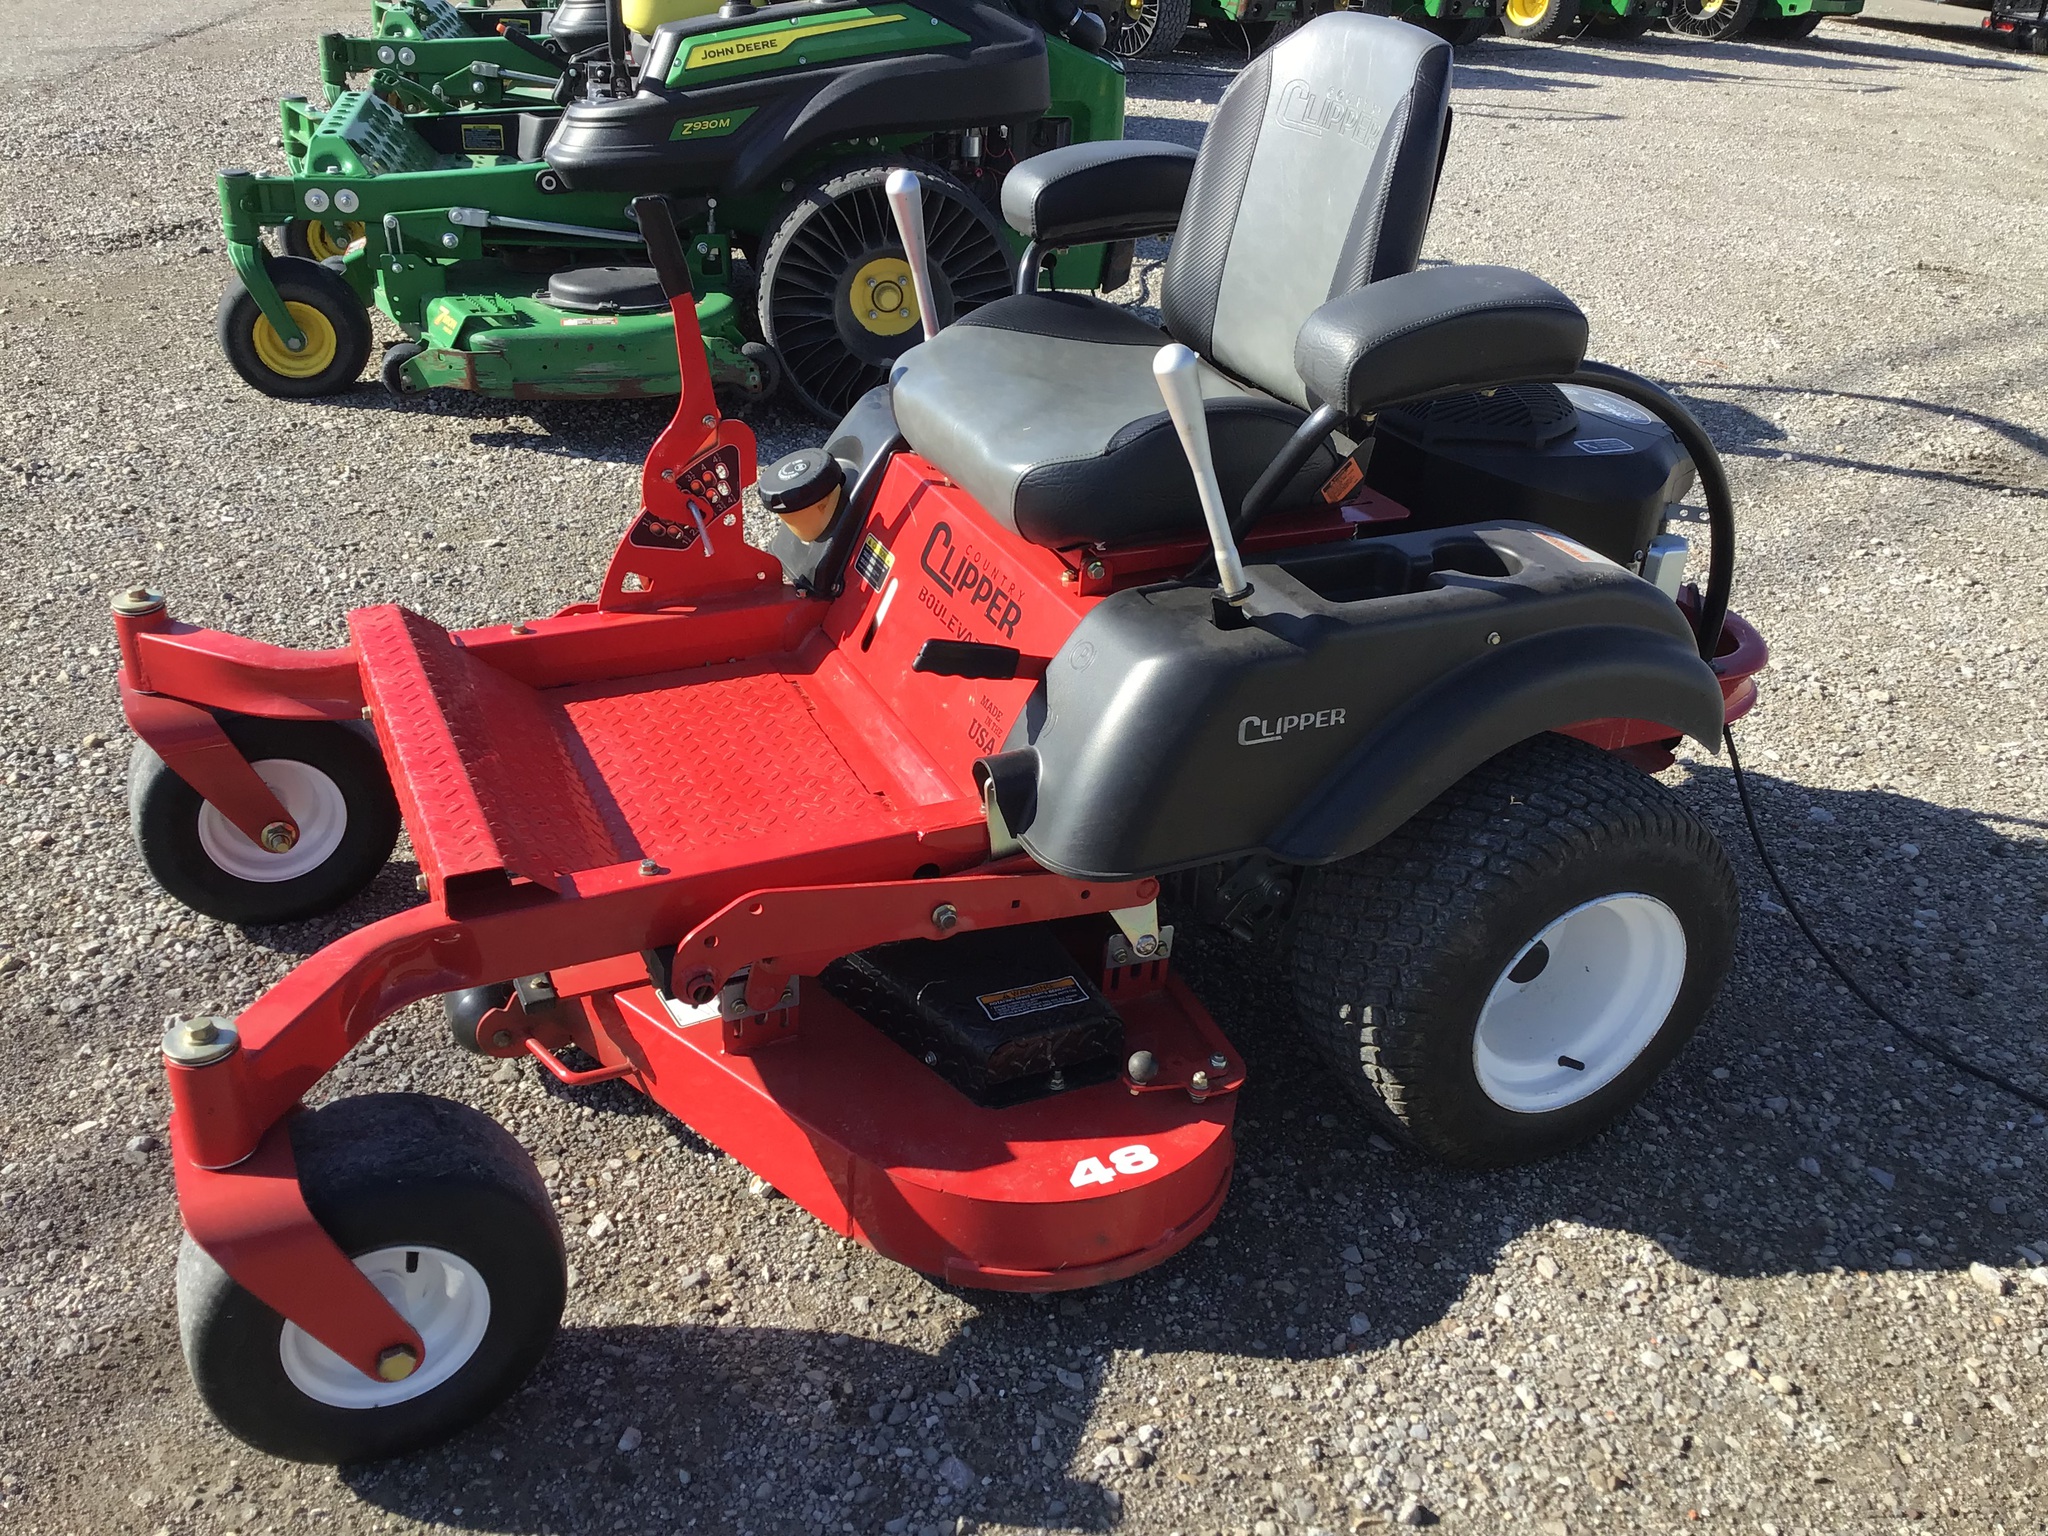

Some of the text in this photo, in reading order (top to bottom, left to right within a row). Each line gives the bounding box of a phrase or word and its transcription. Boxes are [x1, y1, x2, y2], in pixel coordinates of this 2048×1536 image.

[701, 38, 778, 60] JOHN DEERE
[681, 117, 731, 136] Z930M
[1275, 78, 1382, 151] CLIPPER
[920, 520, 1022, 641] CLIPPER
[965, 544, 1026, 603] COUNTRY
[917, 585, 981, 643] BOULEVA
[980, 695, 1004, 723] MADE
[1237, 707, 1347, 746] CLIPPER
[968, 717, 996, 756] USA
[1069, 1144, 1159, 1188] 48
